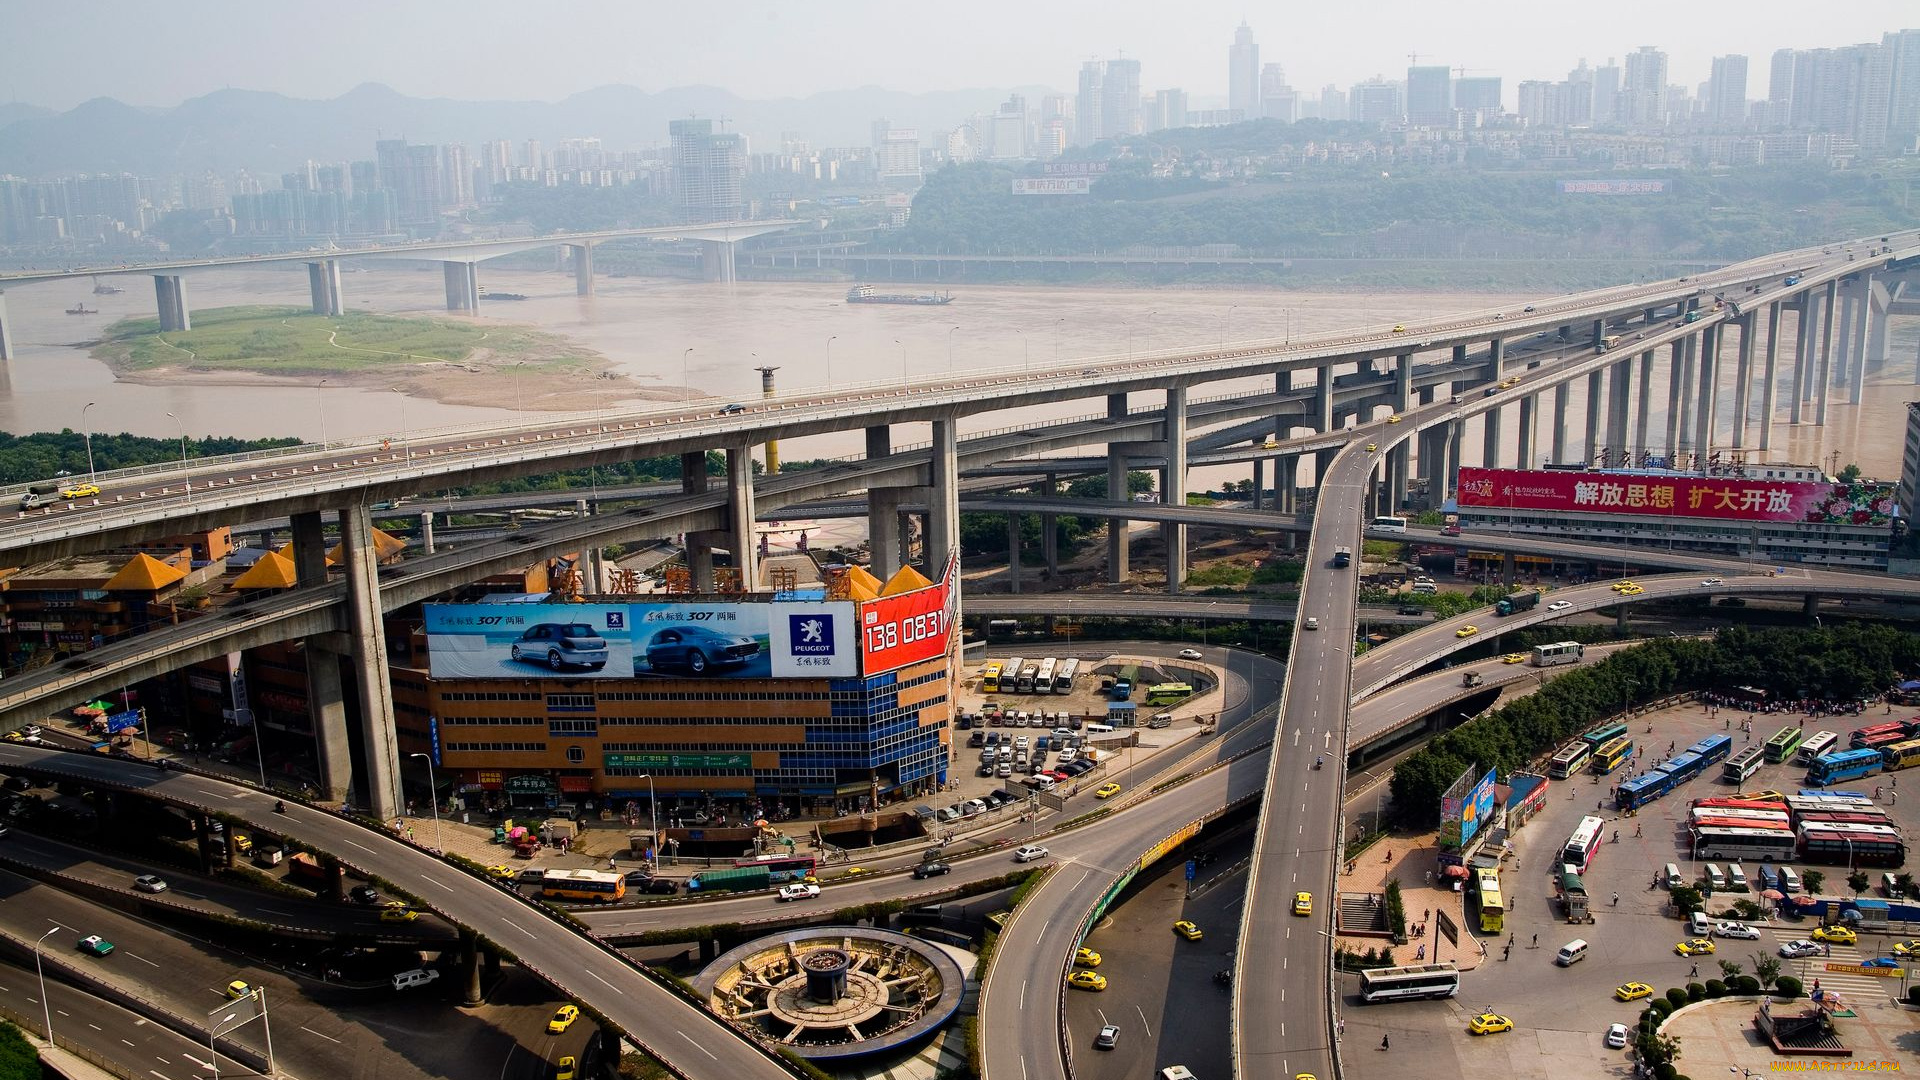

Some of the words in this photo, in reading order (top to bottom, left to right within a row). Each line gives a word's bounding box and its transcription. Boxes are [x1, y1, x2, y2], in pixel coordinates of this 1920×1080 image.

[1574, 480, 1675, 508] 解放思想
[1689, 485, 1793, 513] 扩大开放
[476, 616, 502, 625] 307
[686, 611, 714, 620] 307
[716, 611, 737, 621] 两厢
[866, 621, 898, 653] 138
